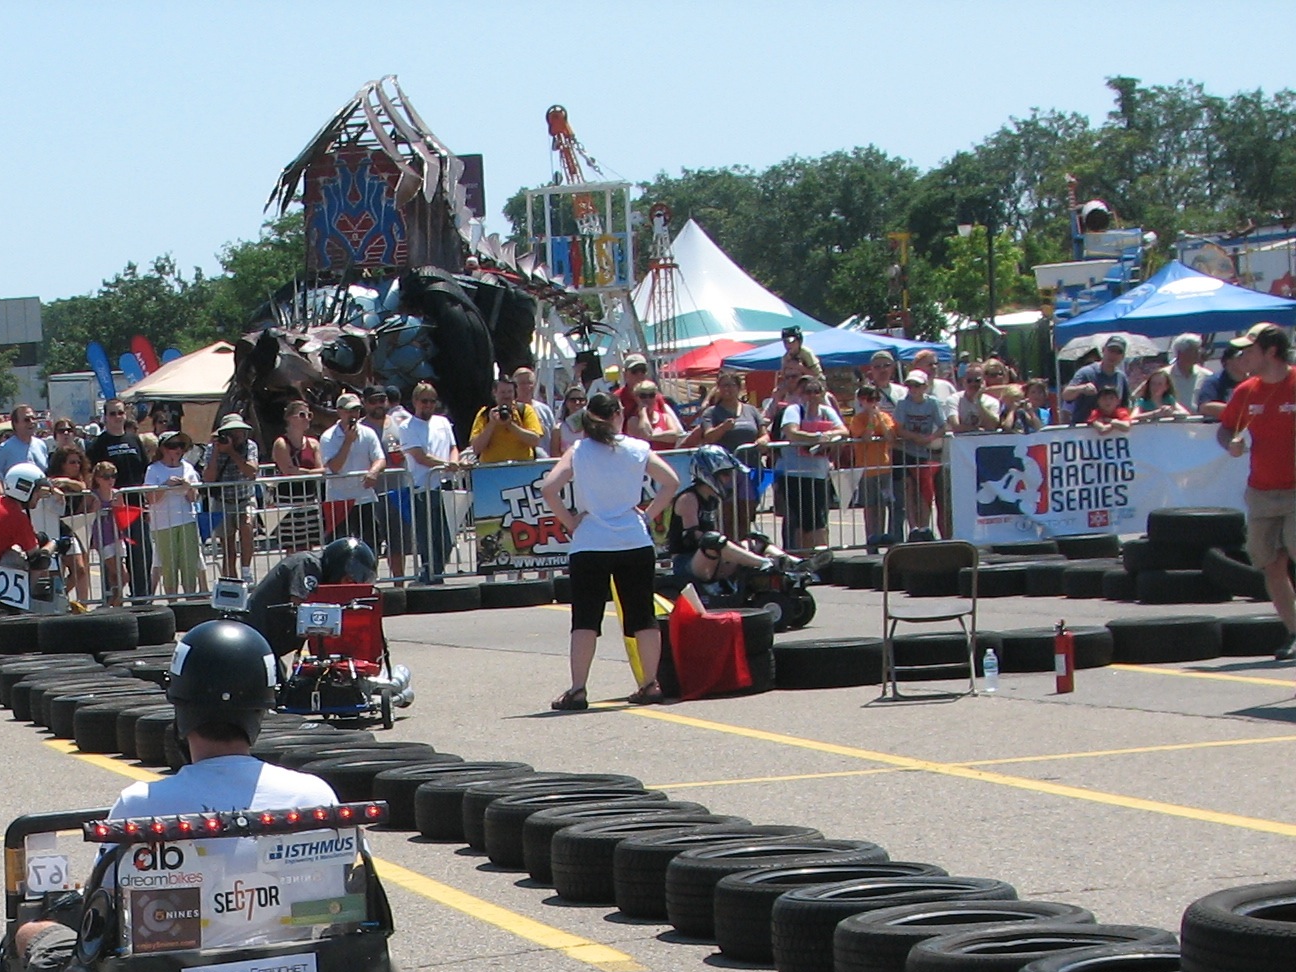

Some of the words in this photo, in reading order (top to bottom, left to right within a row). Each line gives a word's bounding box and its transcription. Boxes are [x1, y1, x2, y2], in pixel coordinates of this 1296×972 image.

[1050, 437, 1131, 464] POWER
[1050, 460, 1136, 488] RACING
[1051, 484, 1129, 513] SERIES
[284, 837, 354, 858] ISTHMUS
[120, 871, 204, 888] dreambikes
